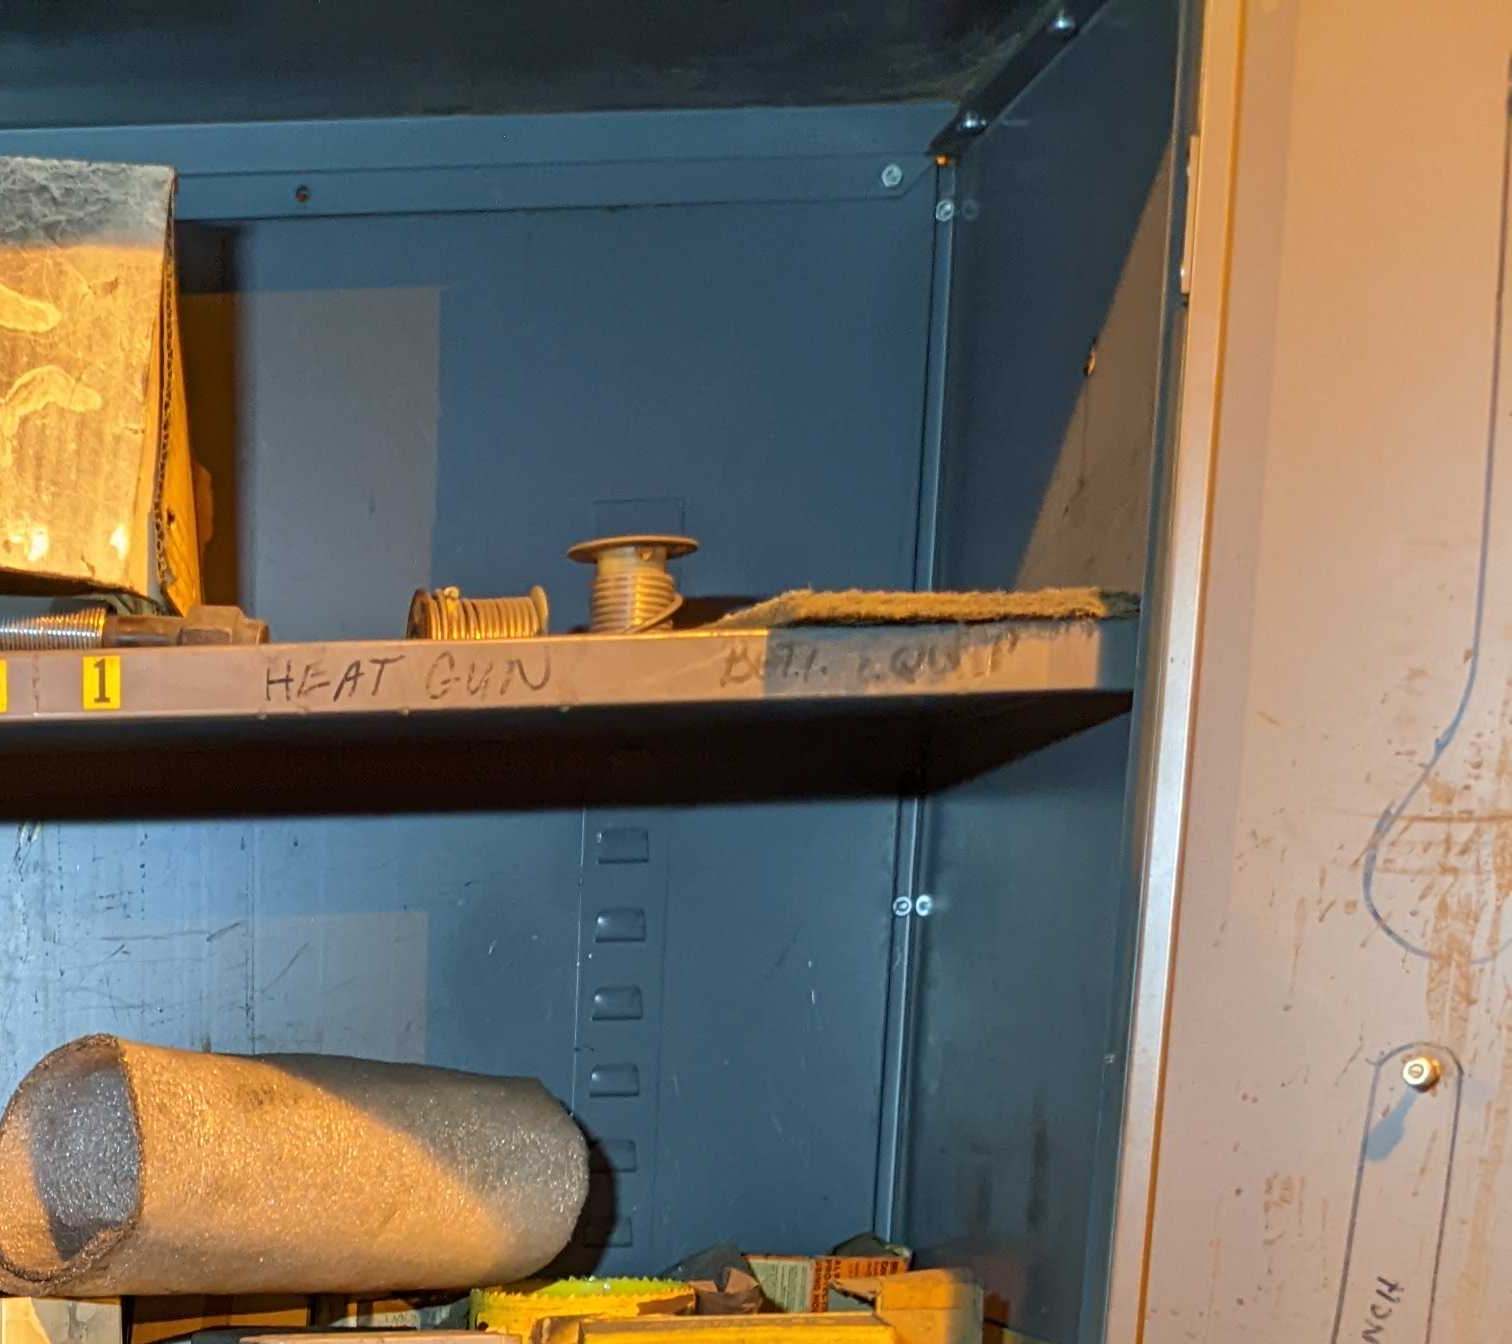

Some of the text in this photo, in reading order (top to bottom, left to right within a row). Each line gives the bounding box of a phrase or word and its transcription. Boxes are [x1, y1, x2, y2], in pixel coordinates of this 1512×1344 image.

[91, 659, 113, 705] 1
[264, 651, 554, 702] HEAT GUN
